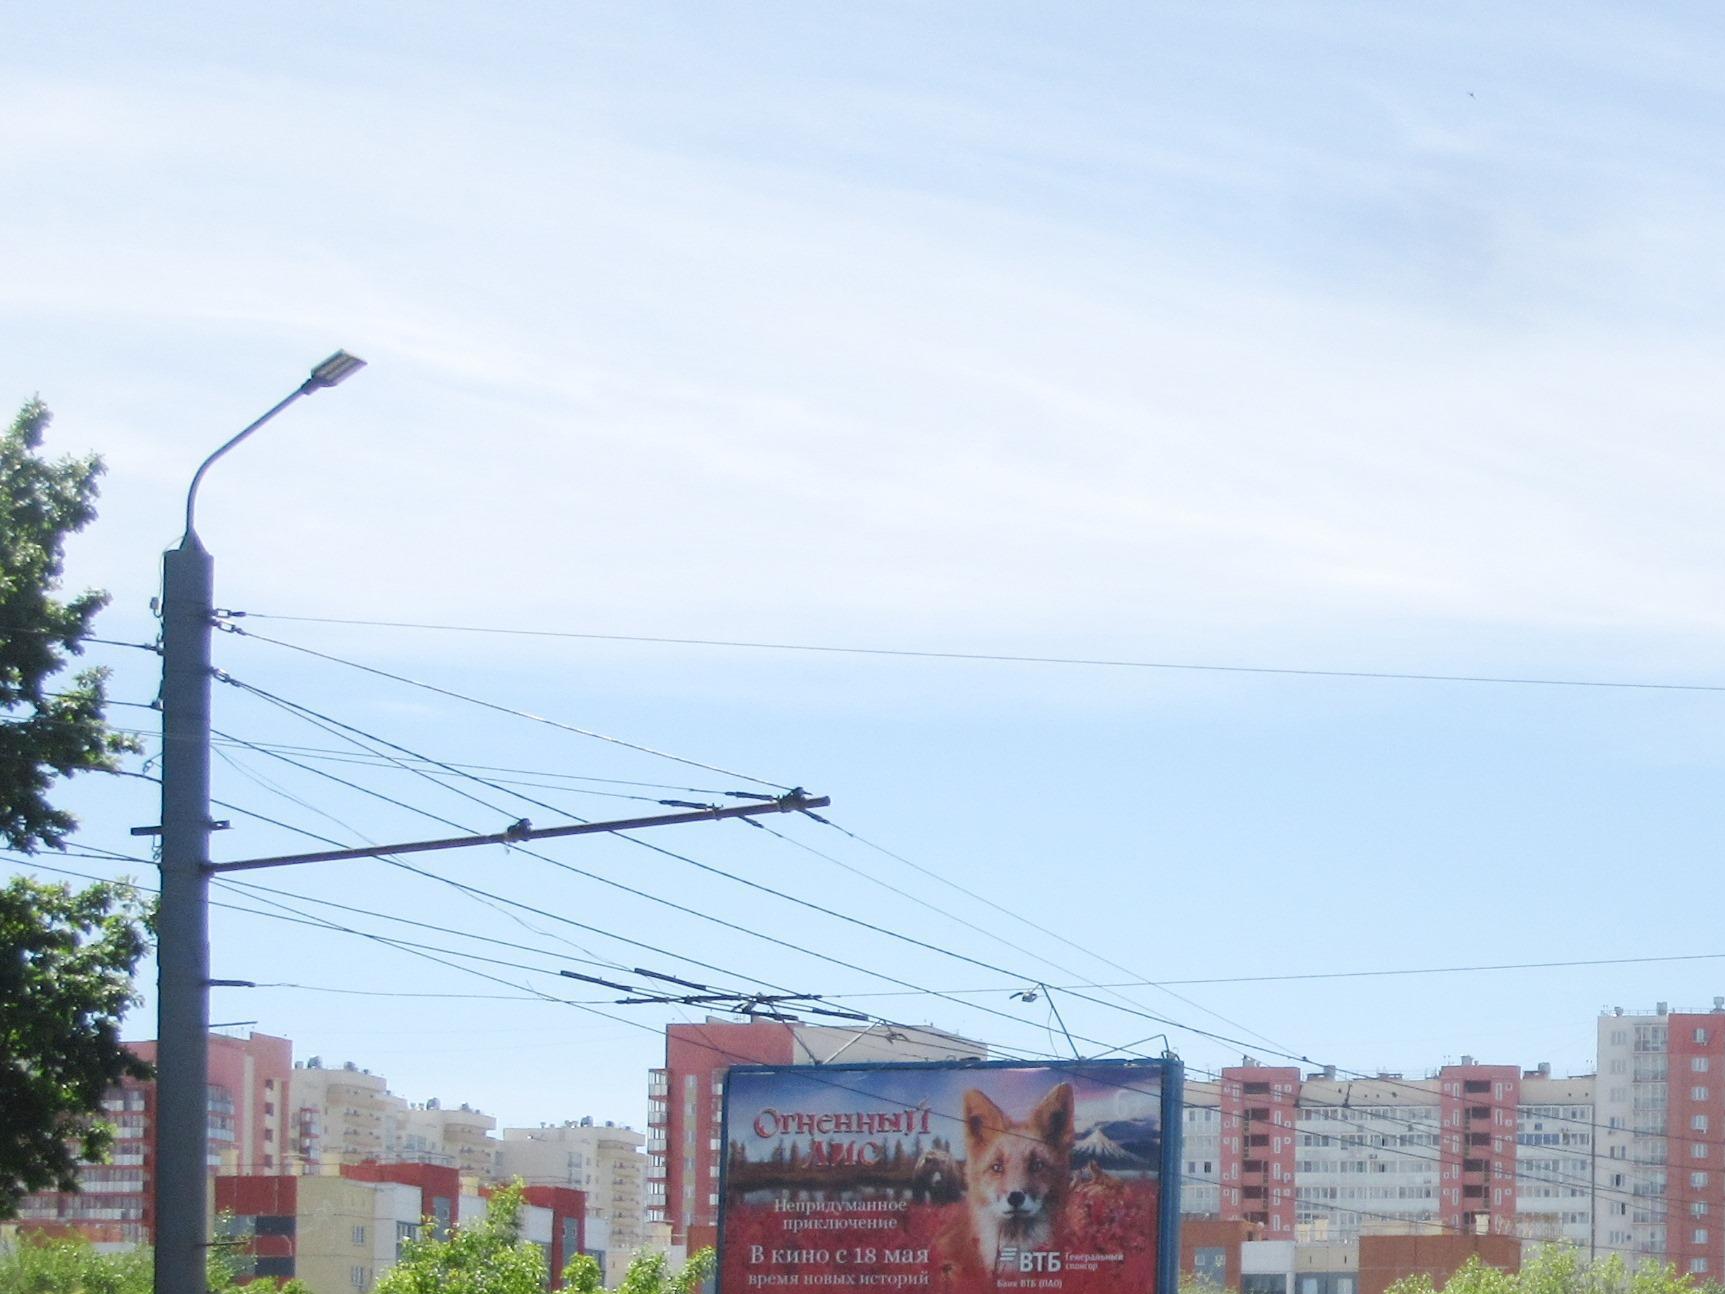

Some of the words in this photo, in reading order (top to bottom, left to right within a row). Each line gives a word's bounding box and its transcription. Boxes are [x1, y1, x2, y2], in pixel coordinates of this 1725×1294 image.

[774, 1199, 907, 1215] Непридуманное
[783, 1218, 898, 1232] приключение
[751, 1245, 764, 1264] В
[772, 1250, 829, 1264] кино
[836, 1250, 847, 1264] с
[854, 1248, 876, 1264] 18
[884, 1250, 929, 1264] мая
[1020, 1252, 1061, 1272] ВТБ
[749, 1274, 799, 1288] время
[803, 1274, 854, 1285] новых
[859, 1271, 929, 1288] историй
